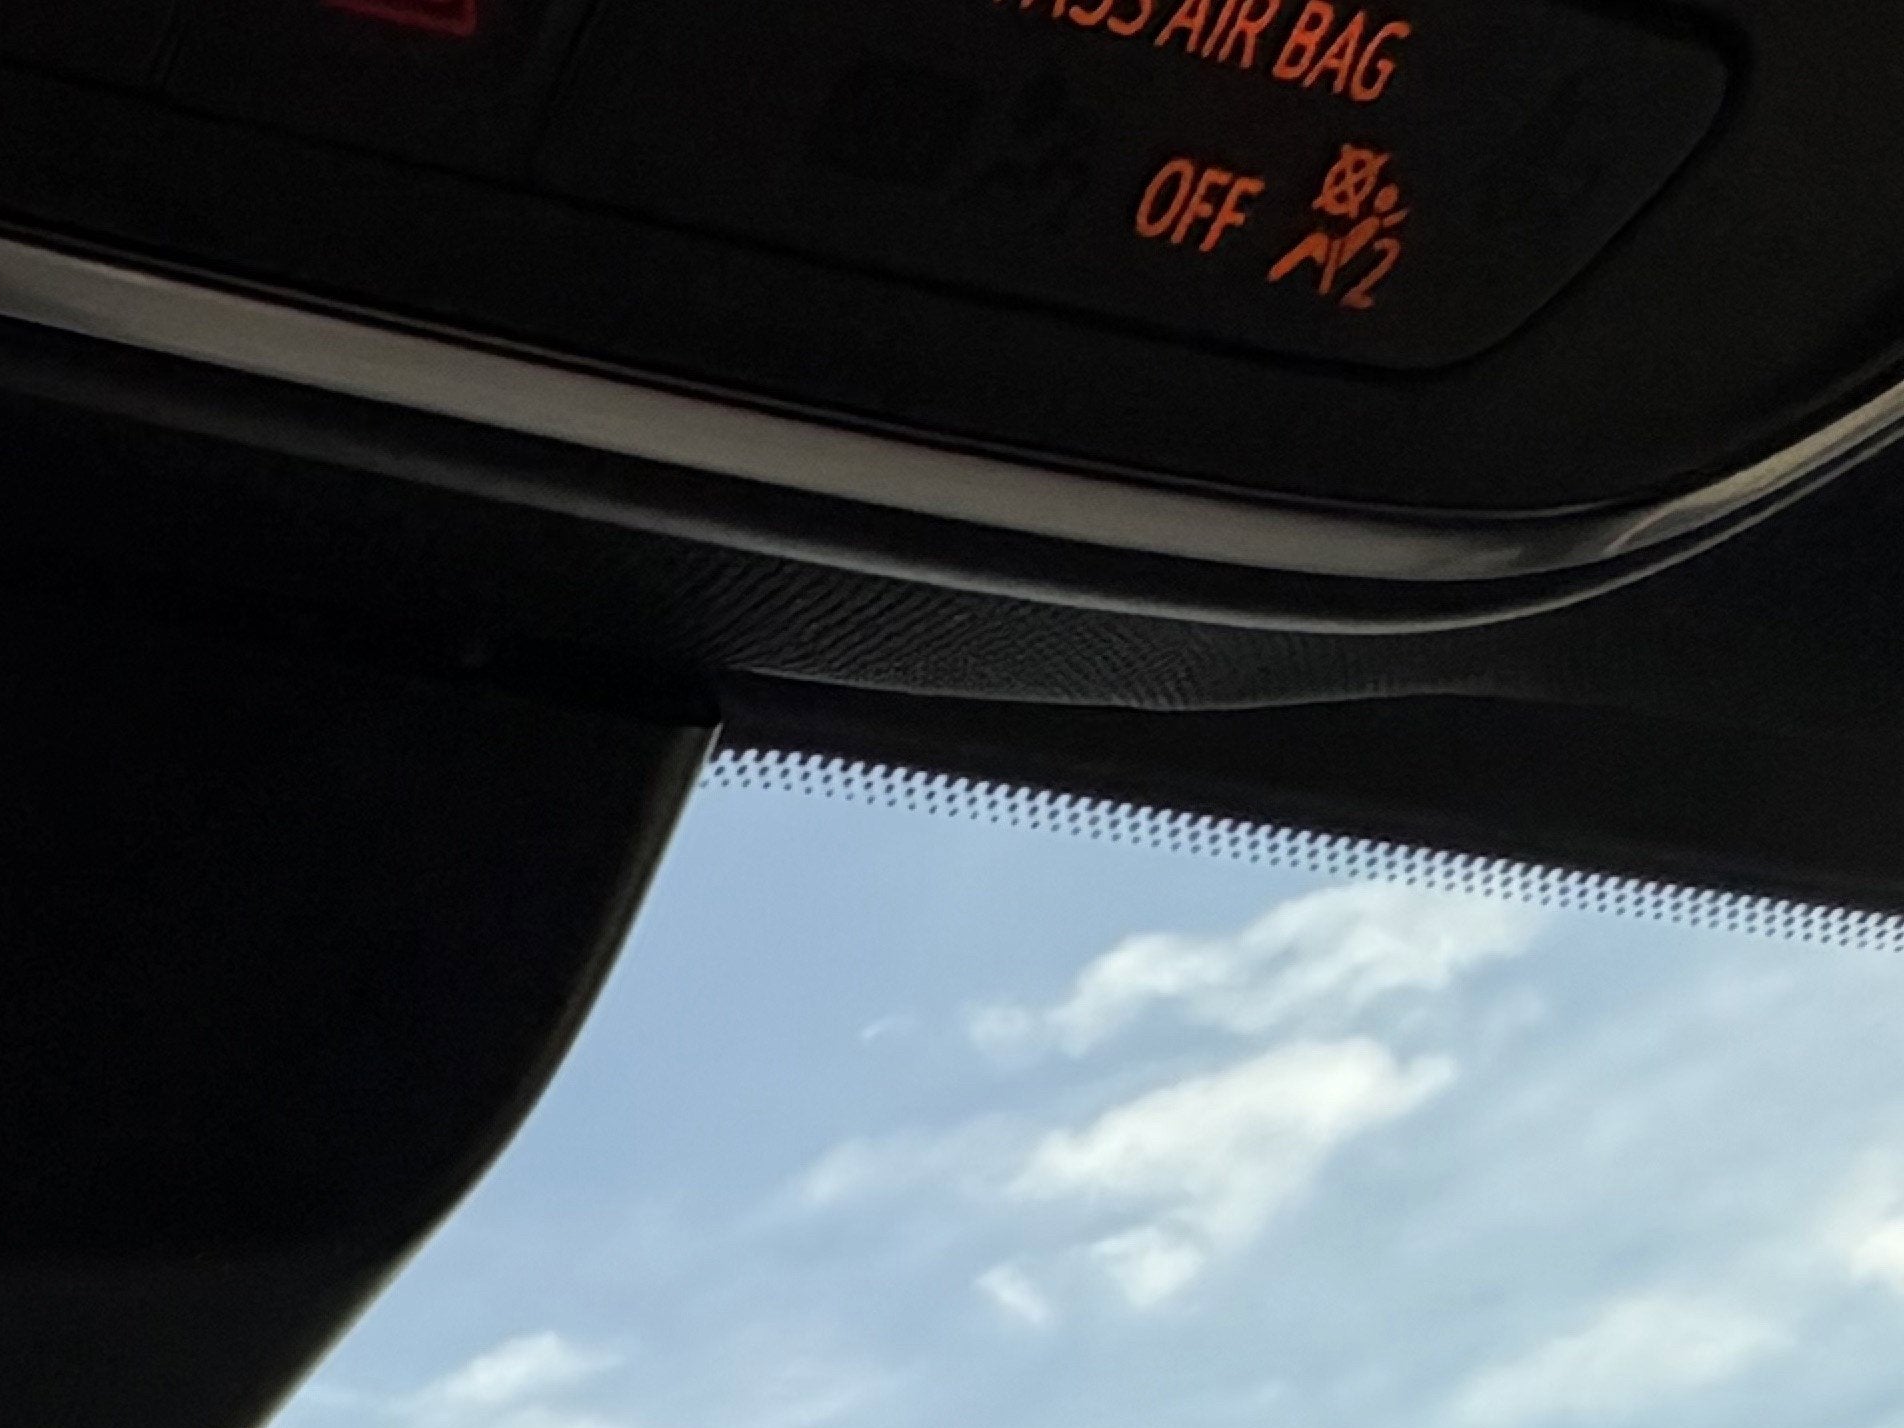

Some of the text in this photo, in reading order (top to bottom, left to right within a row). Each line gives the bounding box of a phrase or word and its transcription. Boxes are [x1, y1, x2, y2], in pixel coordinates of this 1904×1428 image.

[1154, 0, 1280, 68] AIR
[1272, 0, 1411, 101] BAG
[1136, 158, 1265, 252] OFF
